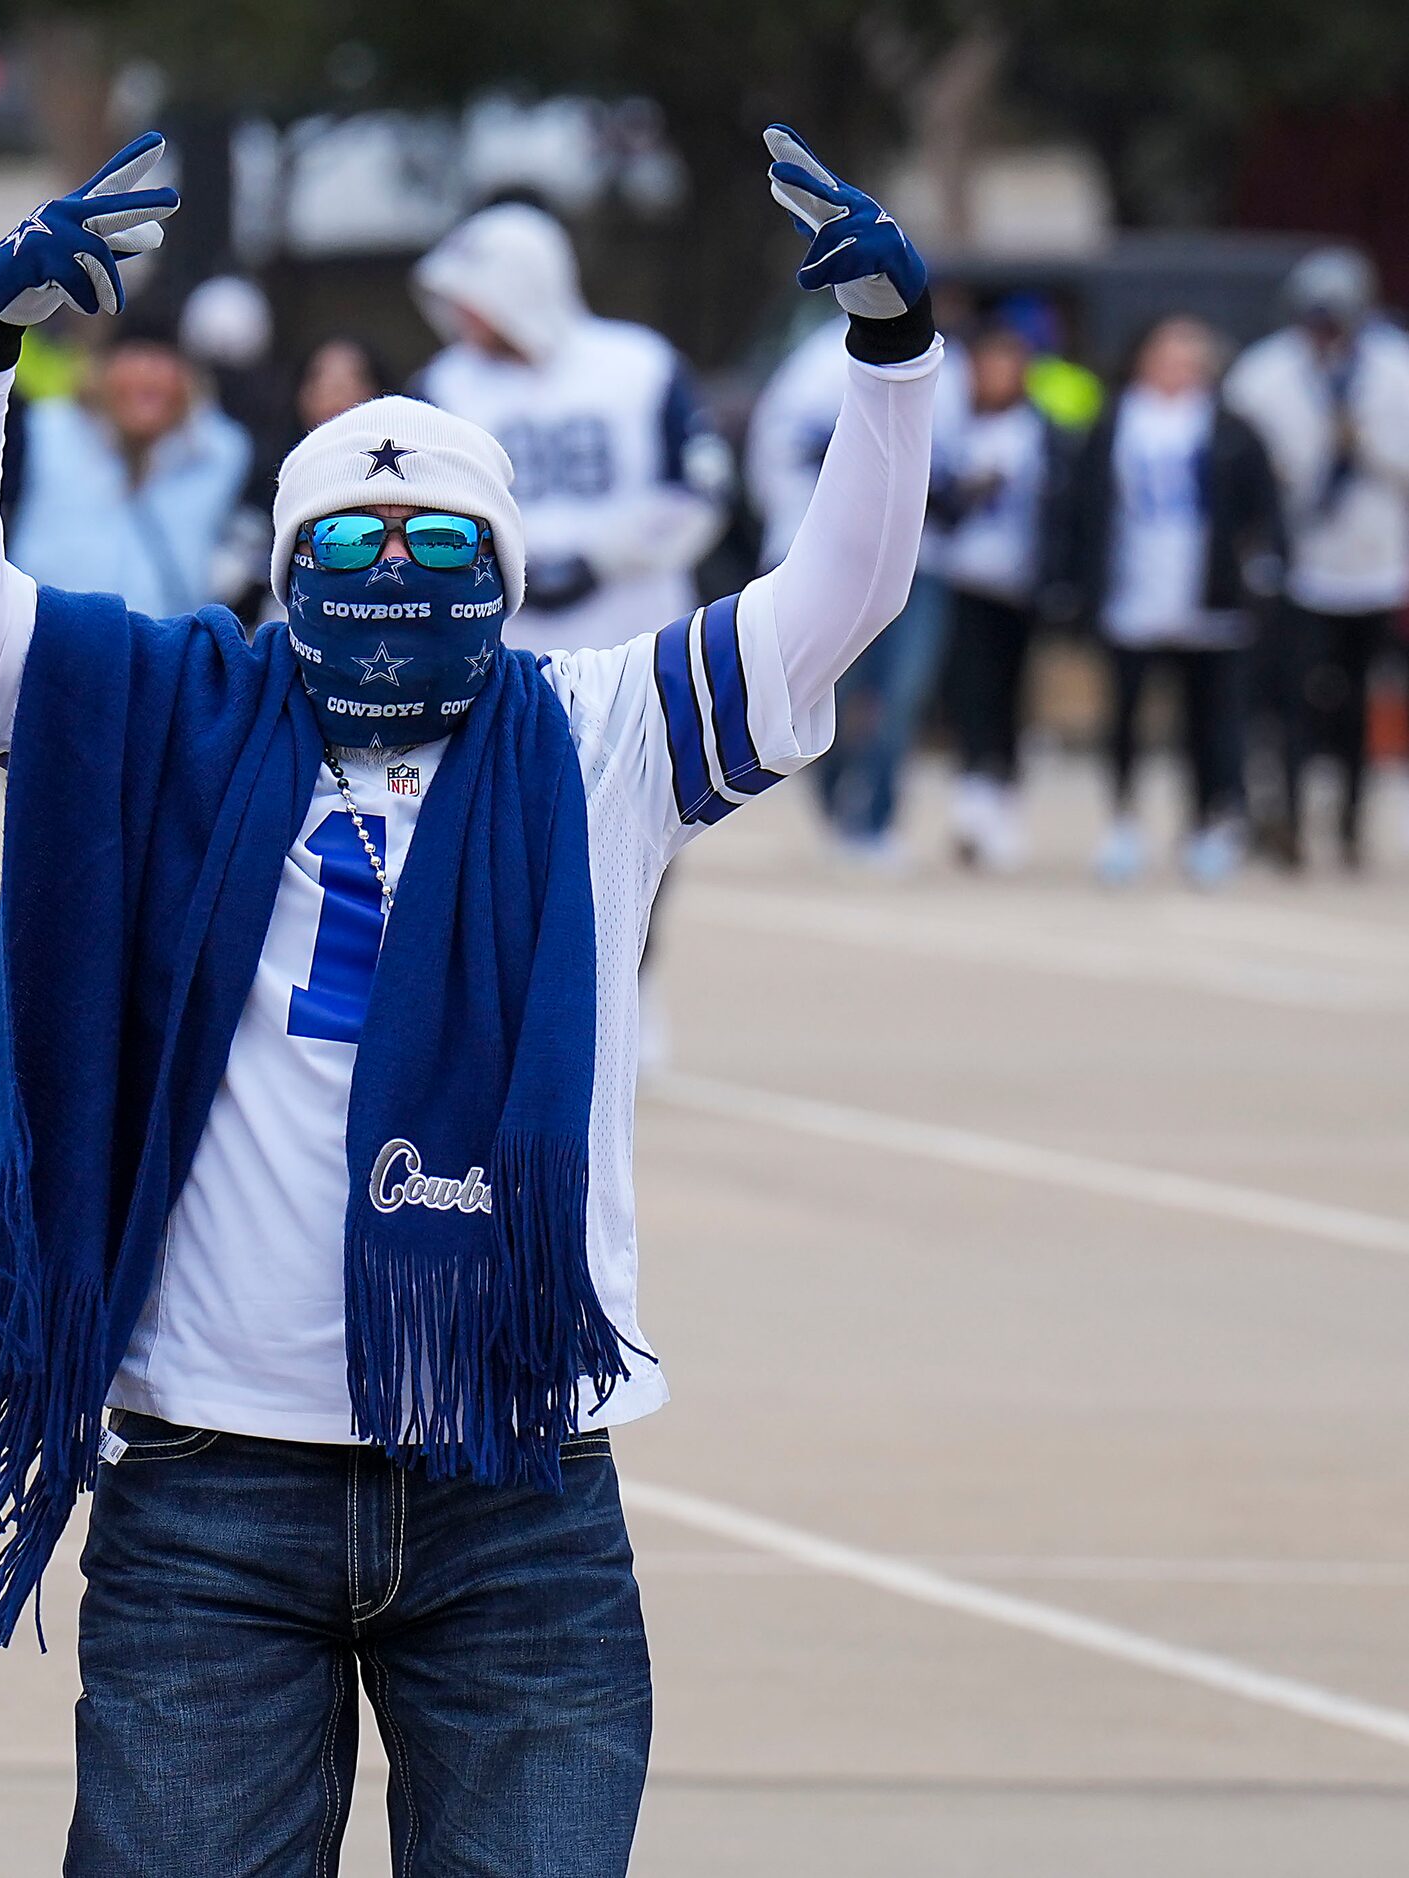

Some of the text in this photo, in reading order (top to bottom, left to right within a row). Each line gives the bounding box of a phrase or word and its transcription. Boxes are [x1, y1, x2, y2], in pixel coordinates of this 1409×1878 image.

[322, 601, 431, 619] COWBOYS
[327, 696, 425, 717] COWBOYS
[391, 779, 417, 795] NFL
[287, 810, 387, 1046] 1
